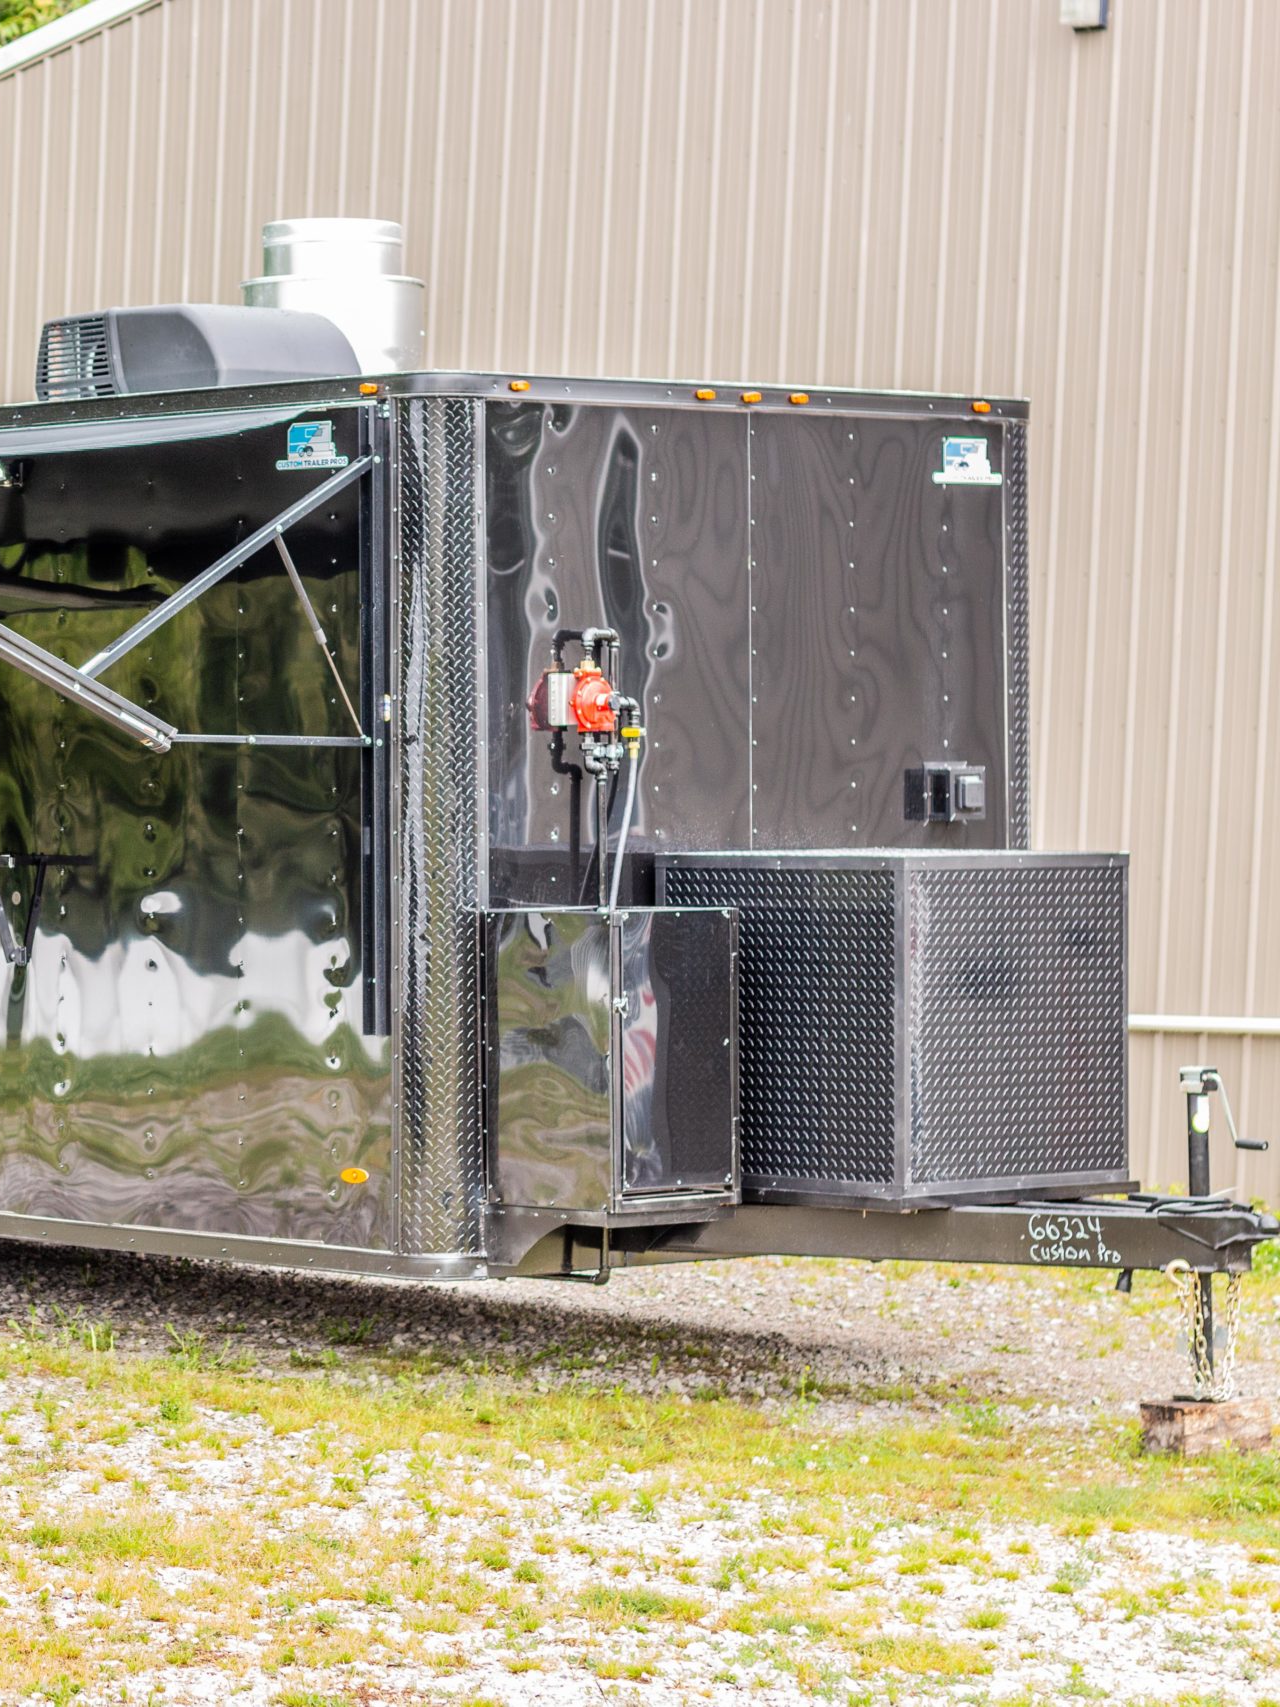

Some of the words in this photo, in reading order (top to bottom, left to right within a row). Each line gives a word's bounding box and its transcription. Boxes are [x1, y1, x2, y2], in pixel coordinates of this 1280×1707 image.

[304, 459, 329, 467] TRAILER
[1028, 1213, 1105, 1241] 66324
[1097, 1241, 1121, 1263] Pro
